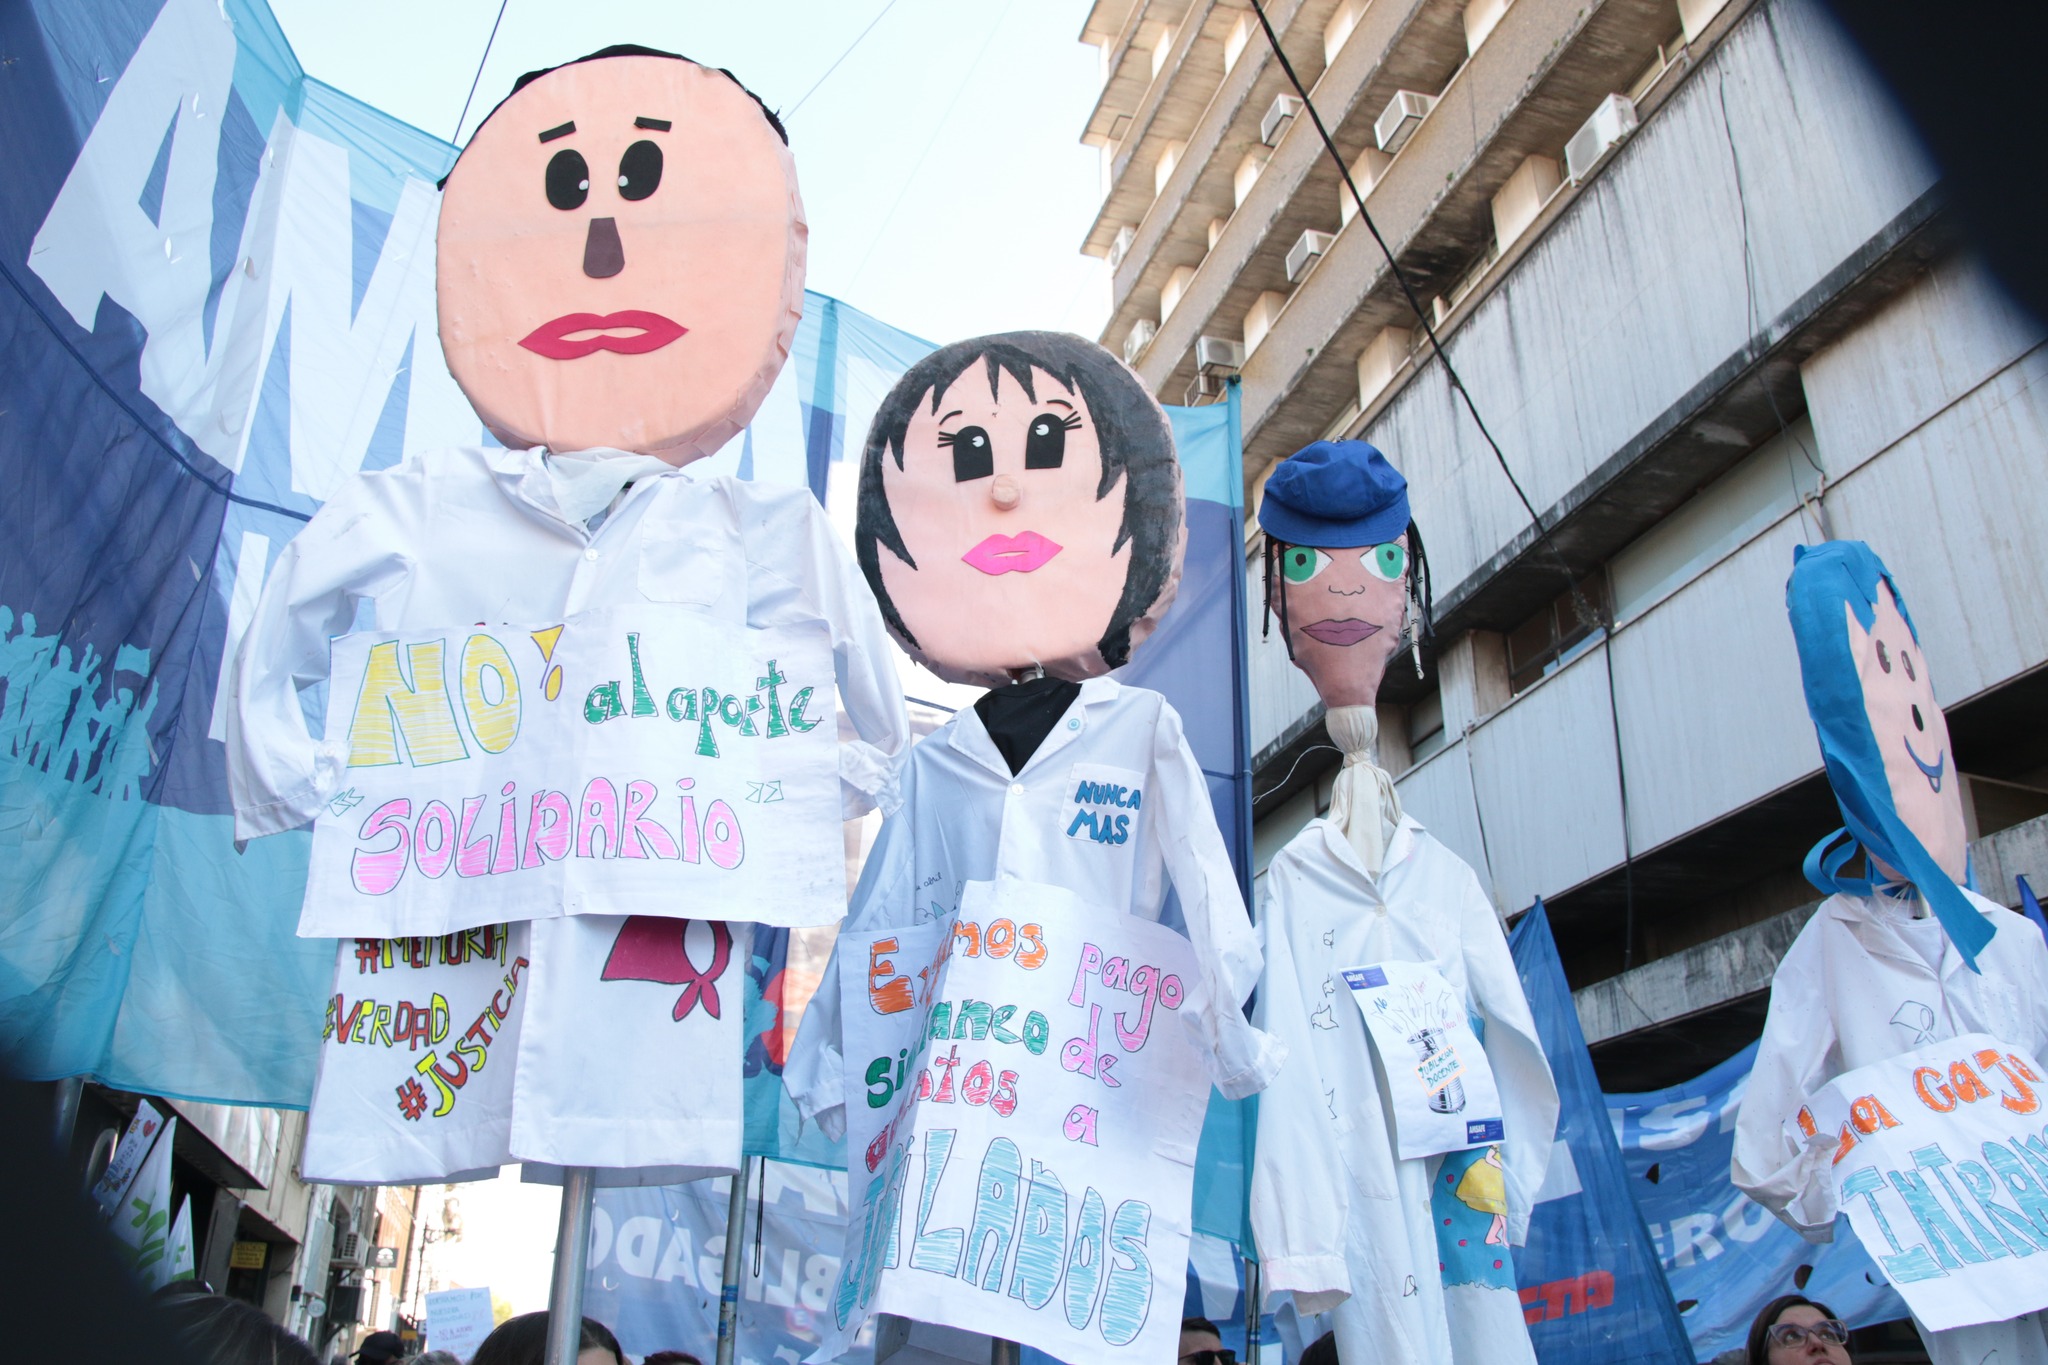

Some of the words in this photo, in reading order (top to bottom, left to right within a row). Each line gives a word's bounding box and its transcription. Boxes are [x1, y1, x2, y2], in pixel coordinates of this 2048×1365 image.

[584, 632, 658, 724] al
[667, 659, 824, 758] aporte
[1074, 780, 1141, 811] NUNCA
[1066, 807, 1130, 845] MAS
[323, 992, 450, 1051] #VERDAD
[1068, 942, 1184, 1053] pago
[1060, 1003, 1122, 1088] de
[1427, 1060, 1460, 1087] DOCENTE
[1062, 1104, 1099, 1147] a
[1841, 1124, 2048, 1284] INTRAN
